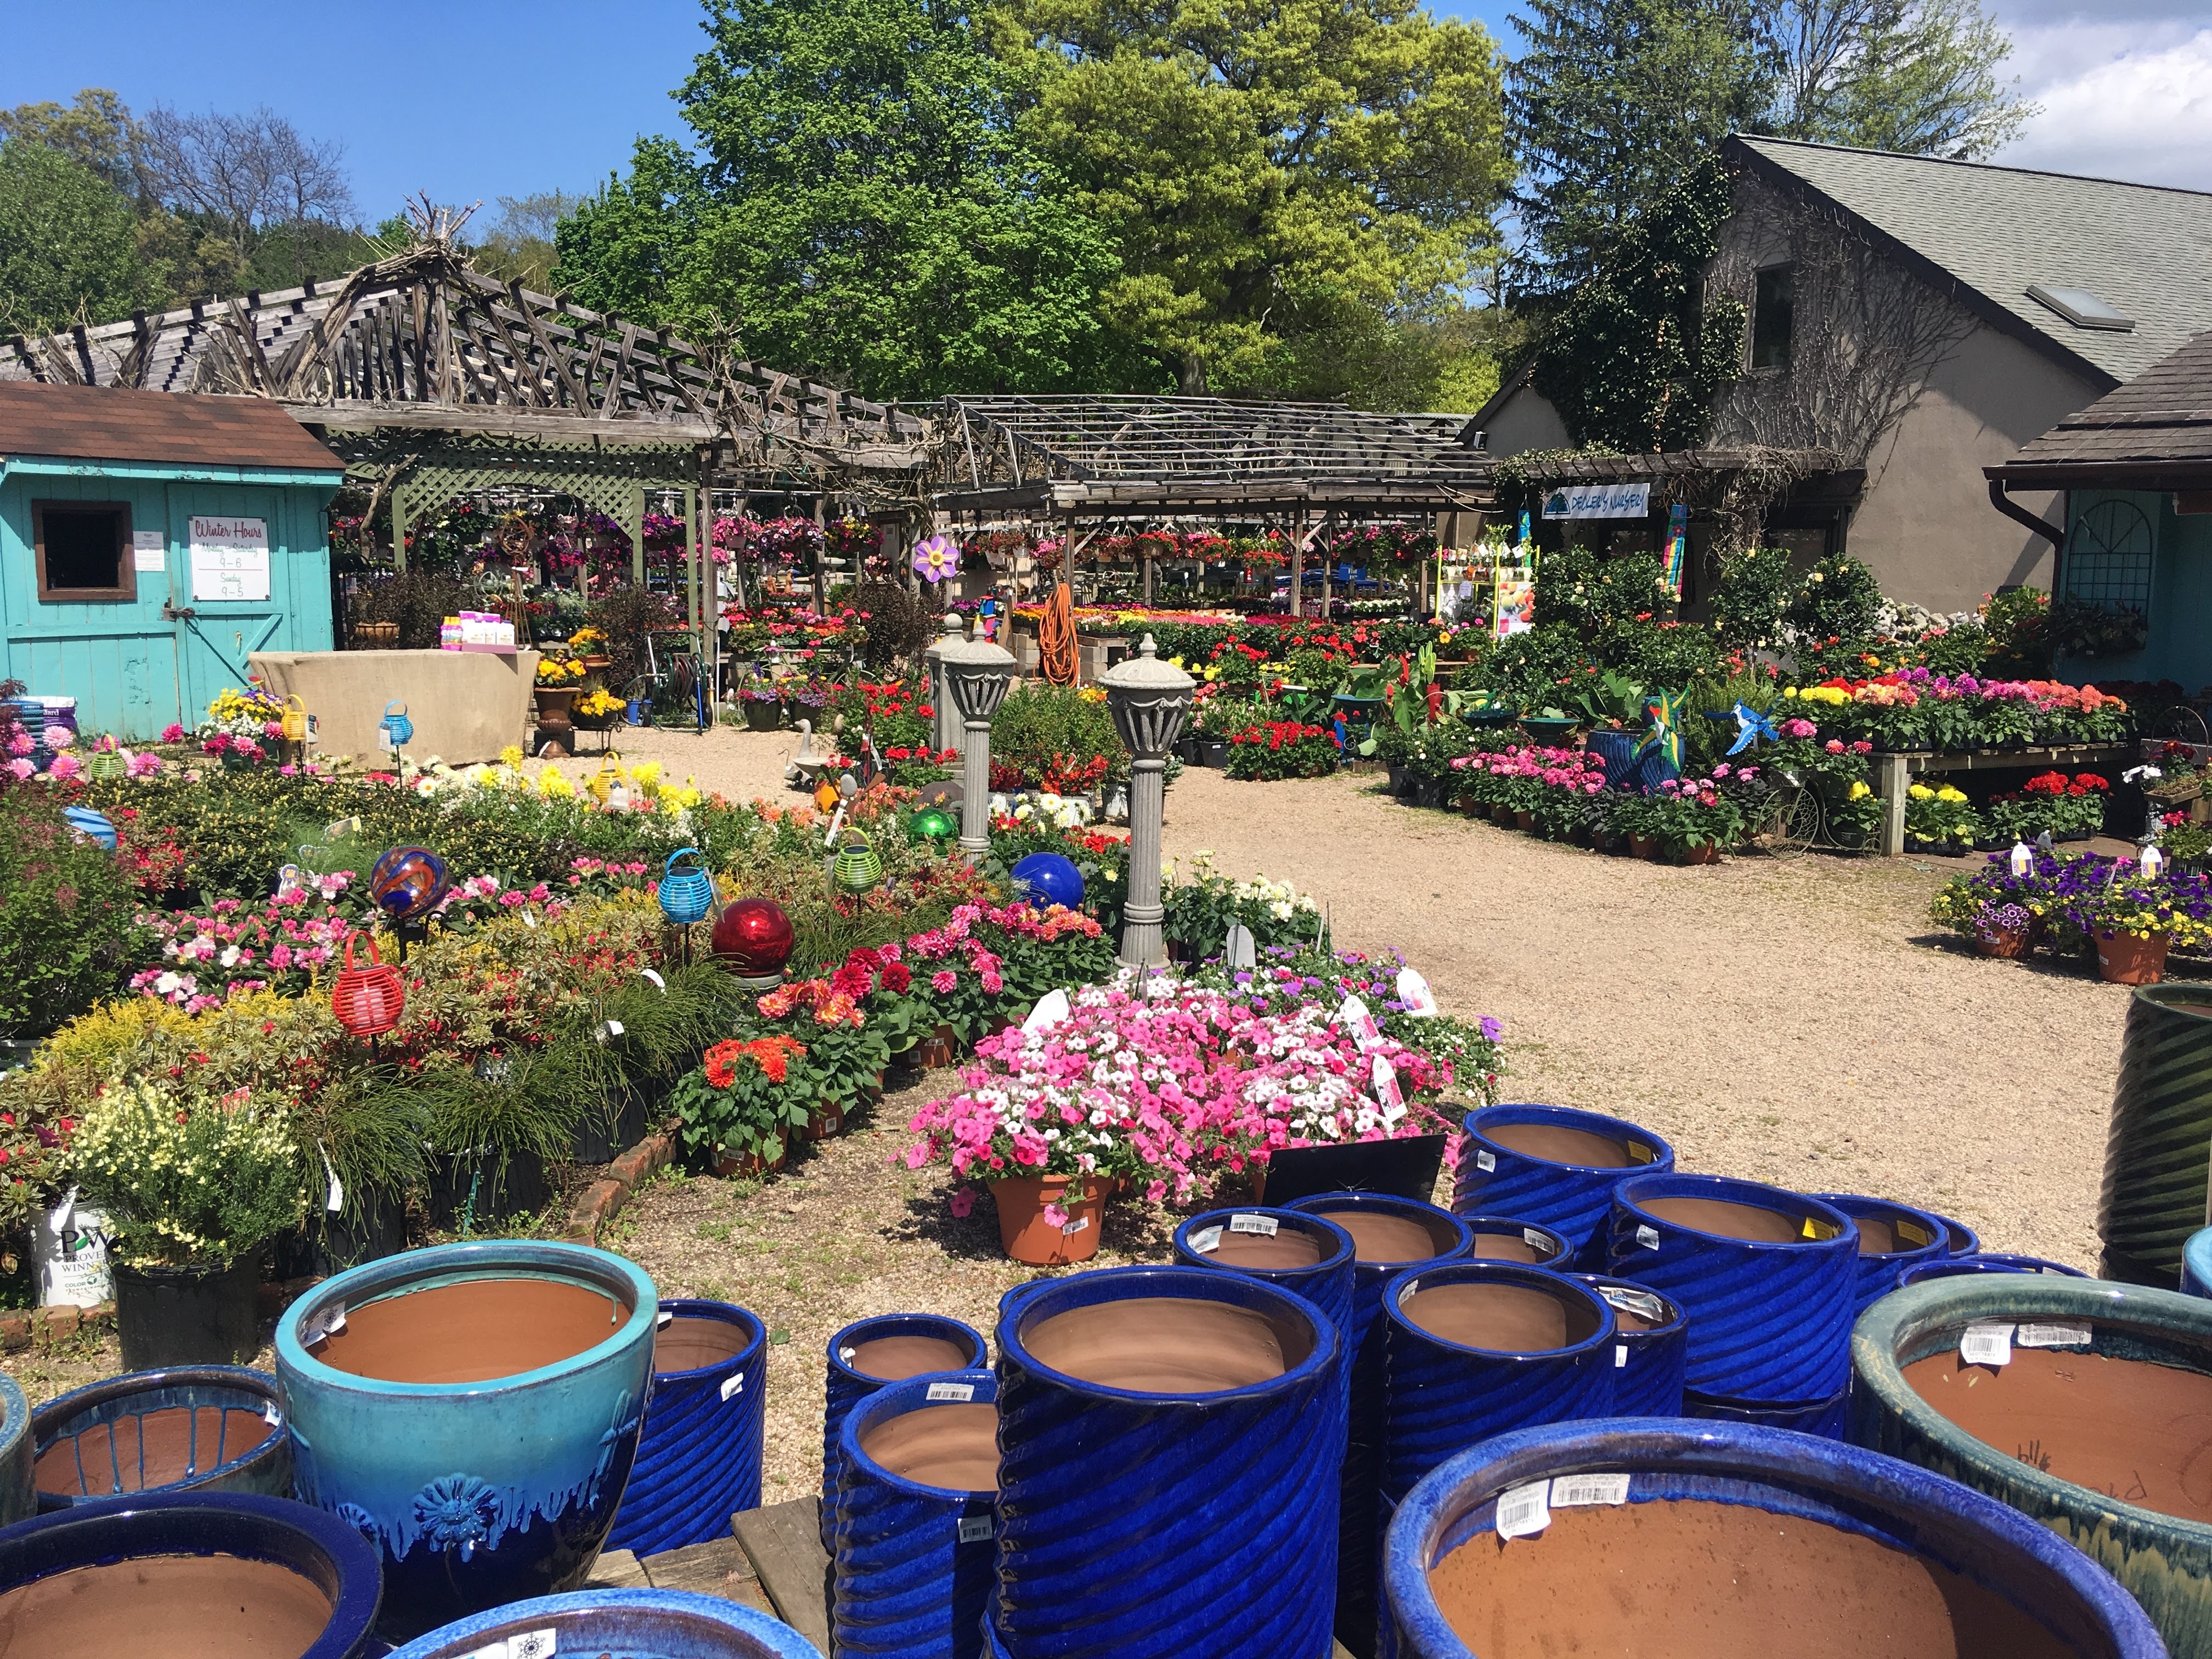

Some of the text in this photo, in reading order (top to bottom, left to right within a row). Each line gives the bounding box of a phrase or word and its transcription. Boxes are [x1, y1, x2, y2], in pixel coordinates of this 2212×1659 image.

[1610, 489, 1645, 514] NURSERY
[195, 520, 262, 538] Winter Hours
[202, 542, 224, 557] Monday
[233, 543, 258, 558] Saturday
[221, 572, 242, 587] Sunday
[66, 1251, 103, 1263] PROVE
